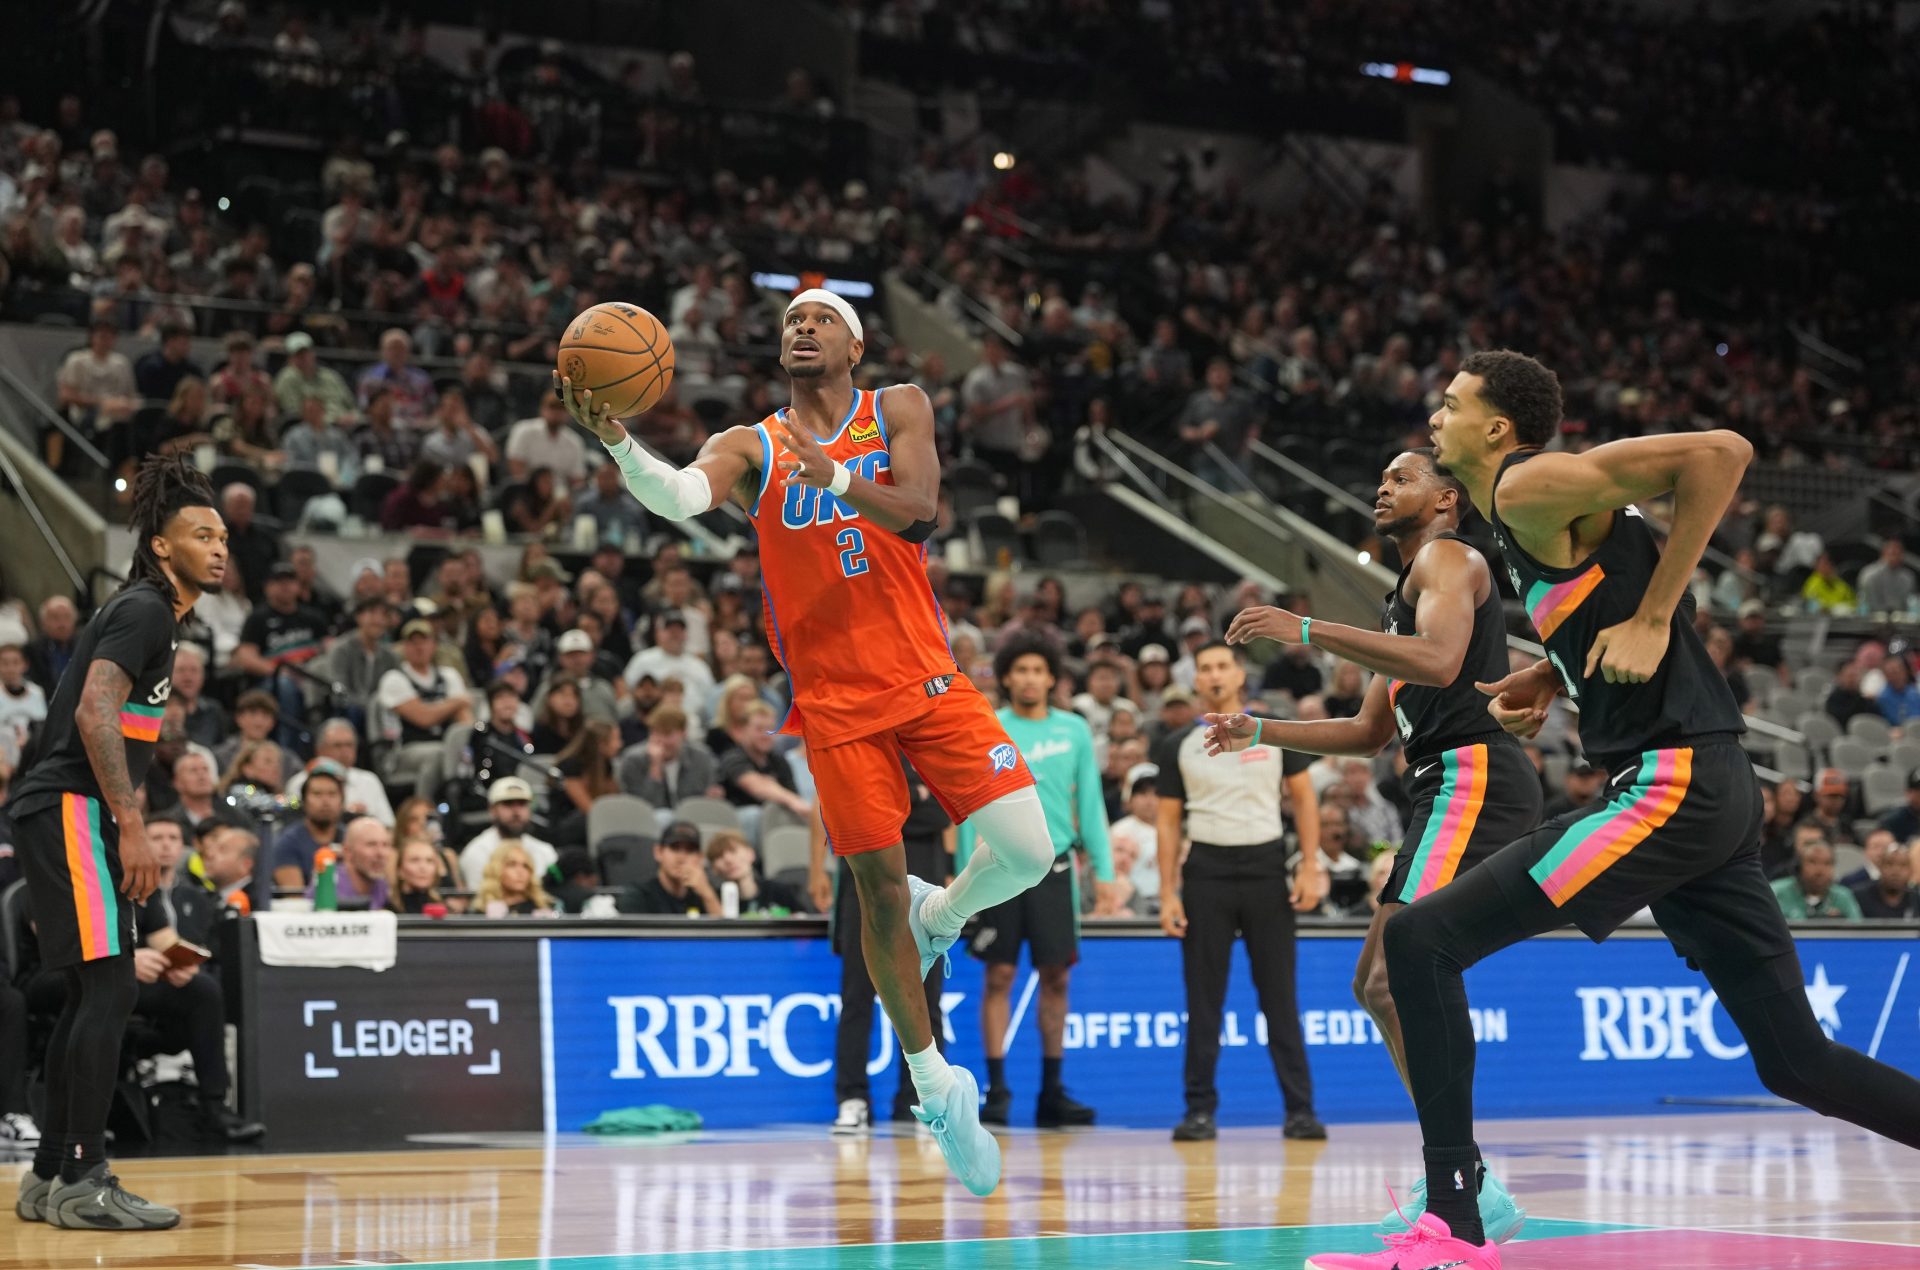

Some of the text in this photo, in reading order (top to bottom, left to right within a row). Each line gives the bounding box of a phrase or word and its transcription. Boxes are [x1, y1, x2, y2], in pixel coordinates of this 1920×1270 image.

[836, 527, 869, 578] 2
[1549, 650, 1580, 699] 1
[284, 925, 370, 937] GATORADE
[332, 1018, 474, 1057] LEDGER
[1062, 1011, 1249, 1049] OFFICL
[1575, 985, 1749, 1060] RBFC
